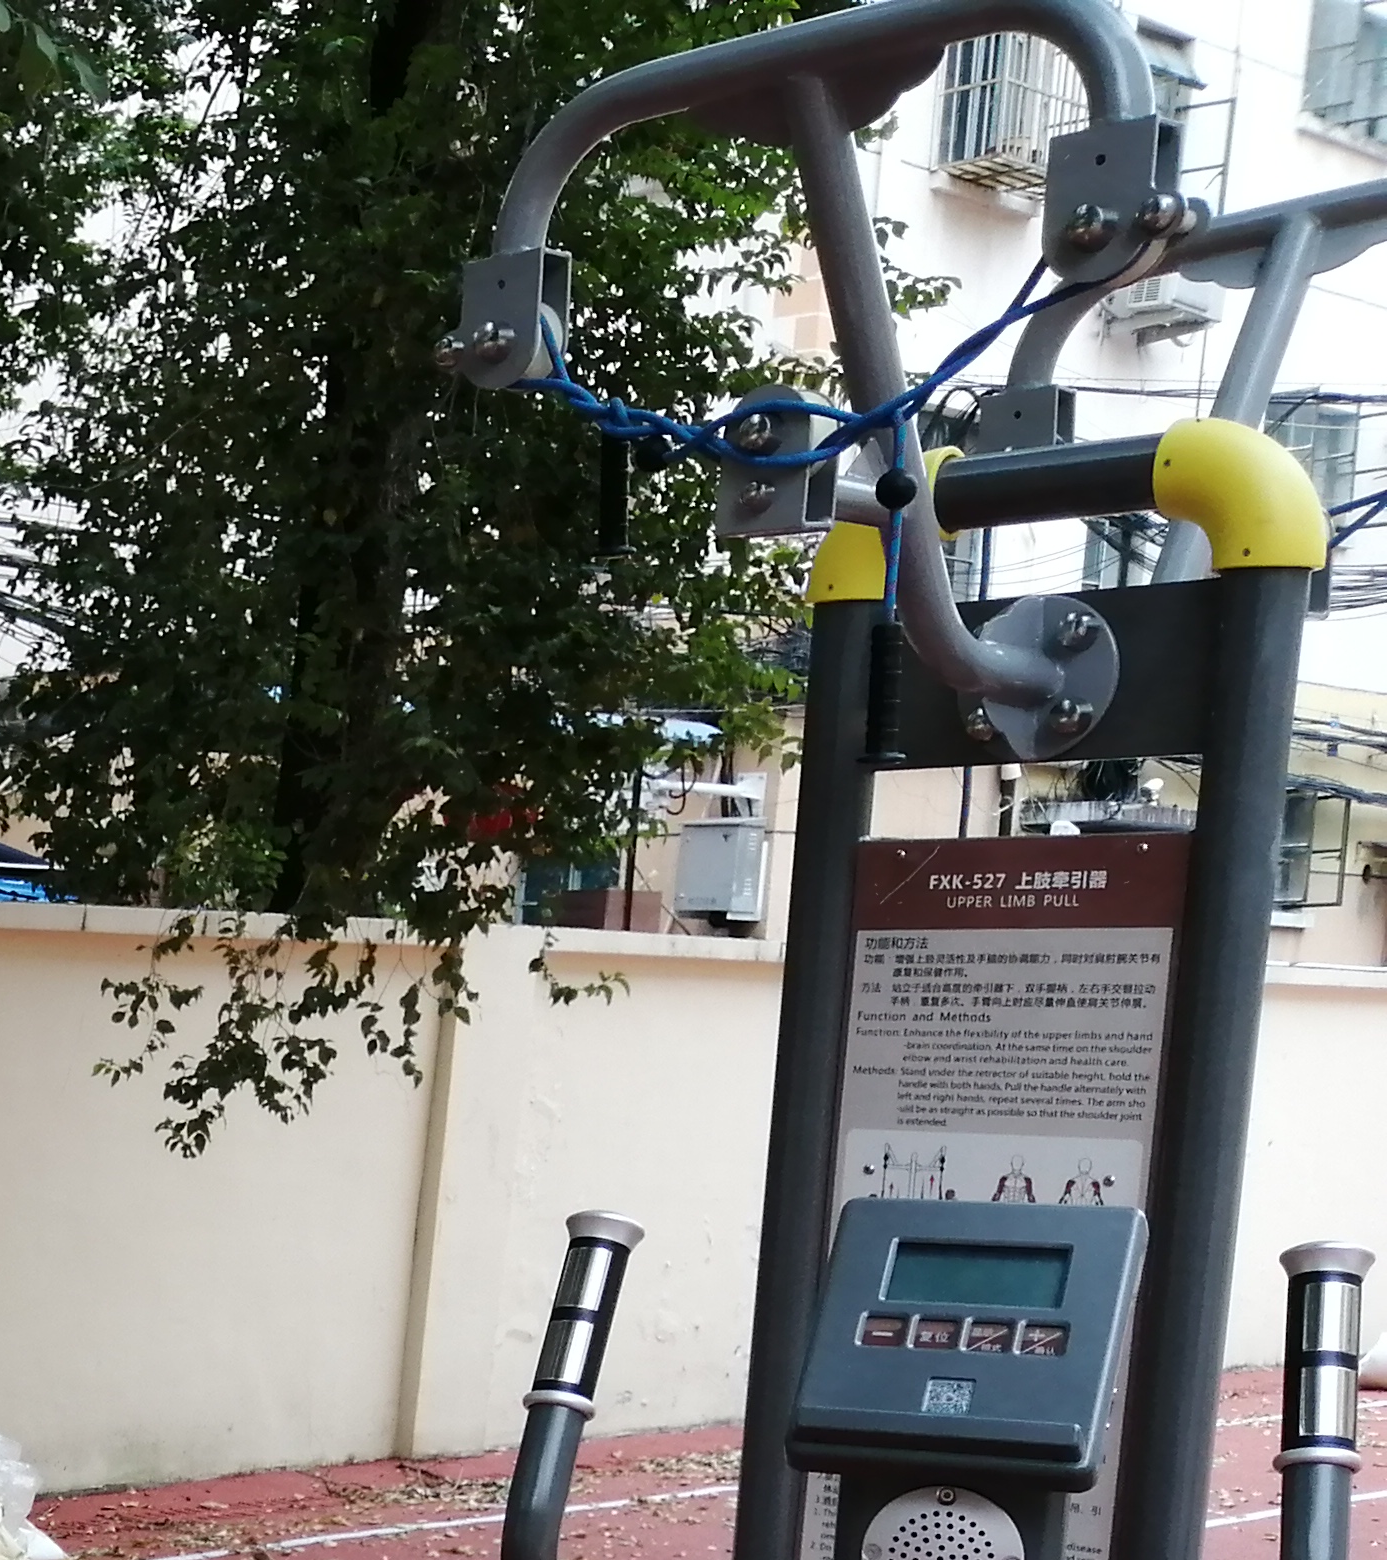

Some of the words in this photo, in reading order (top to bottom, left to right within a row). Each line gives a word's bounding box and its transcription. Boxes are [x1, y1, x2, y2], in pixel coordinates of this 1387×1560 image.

[928, 872, 1006, 890] FXK-527
[1014, 869, 1107, 889] 上肢牵引器
[946, 895, 992, 908] UPPER
[999, 894, 1035, 908] LIMB
[1042, 893, 1079, 907] PULL
[864, 936, 928, 950] 功能和方法
[856, 1009, 906, 1021] Function
[939, 1011, 991, 1023] Methods
